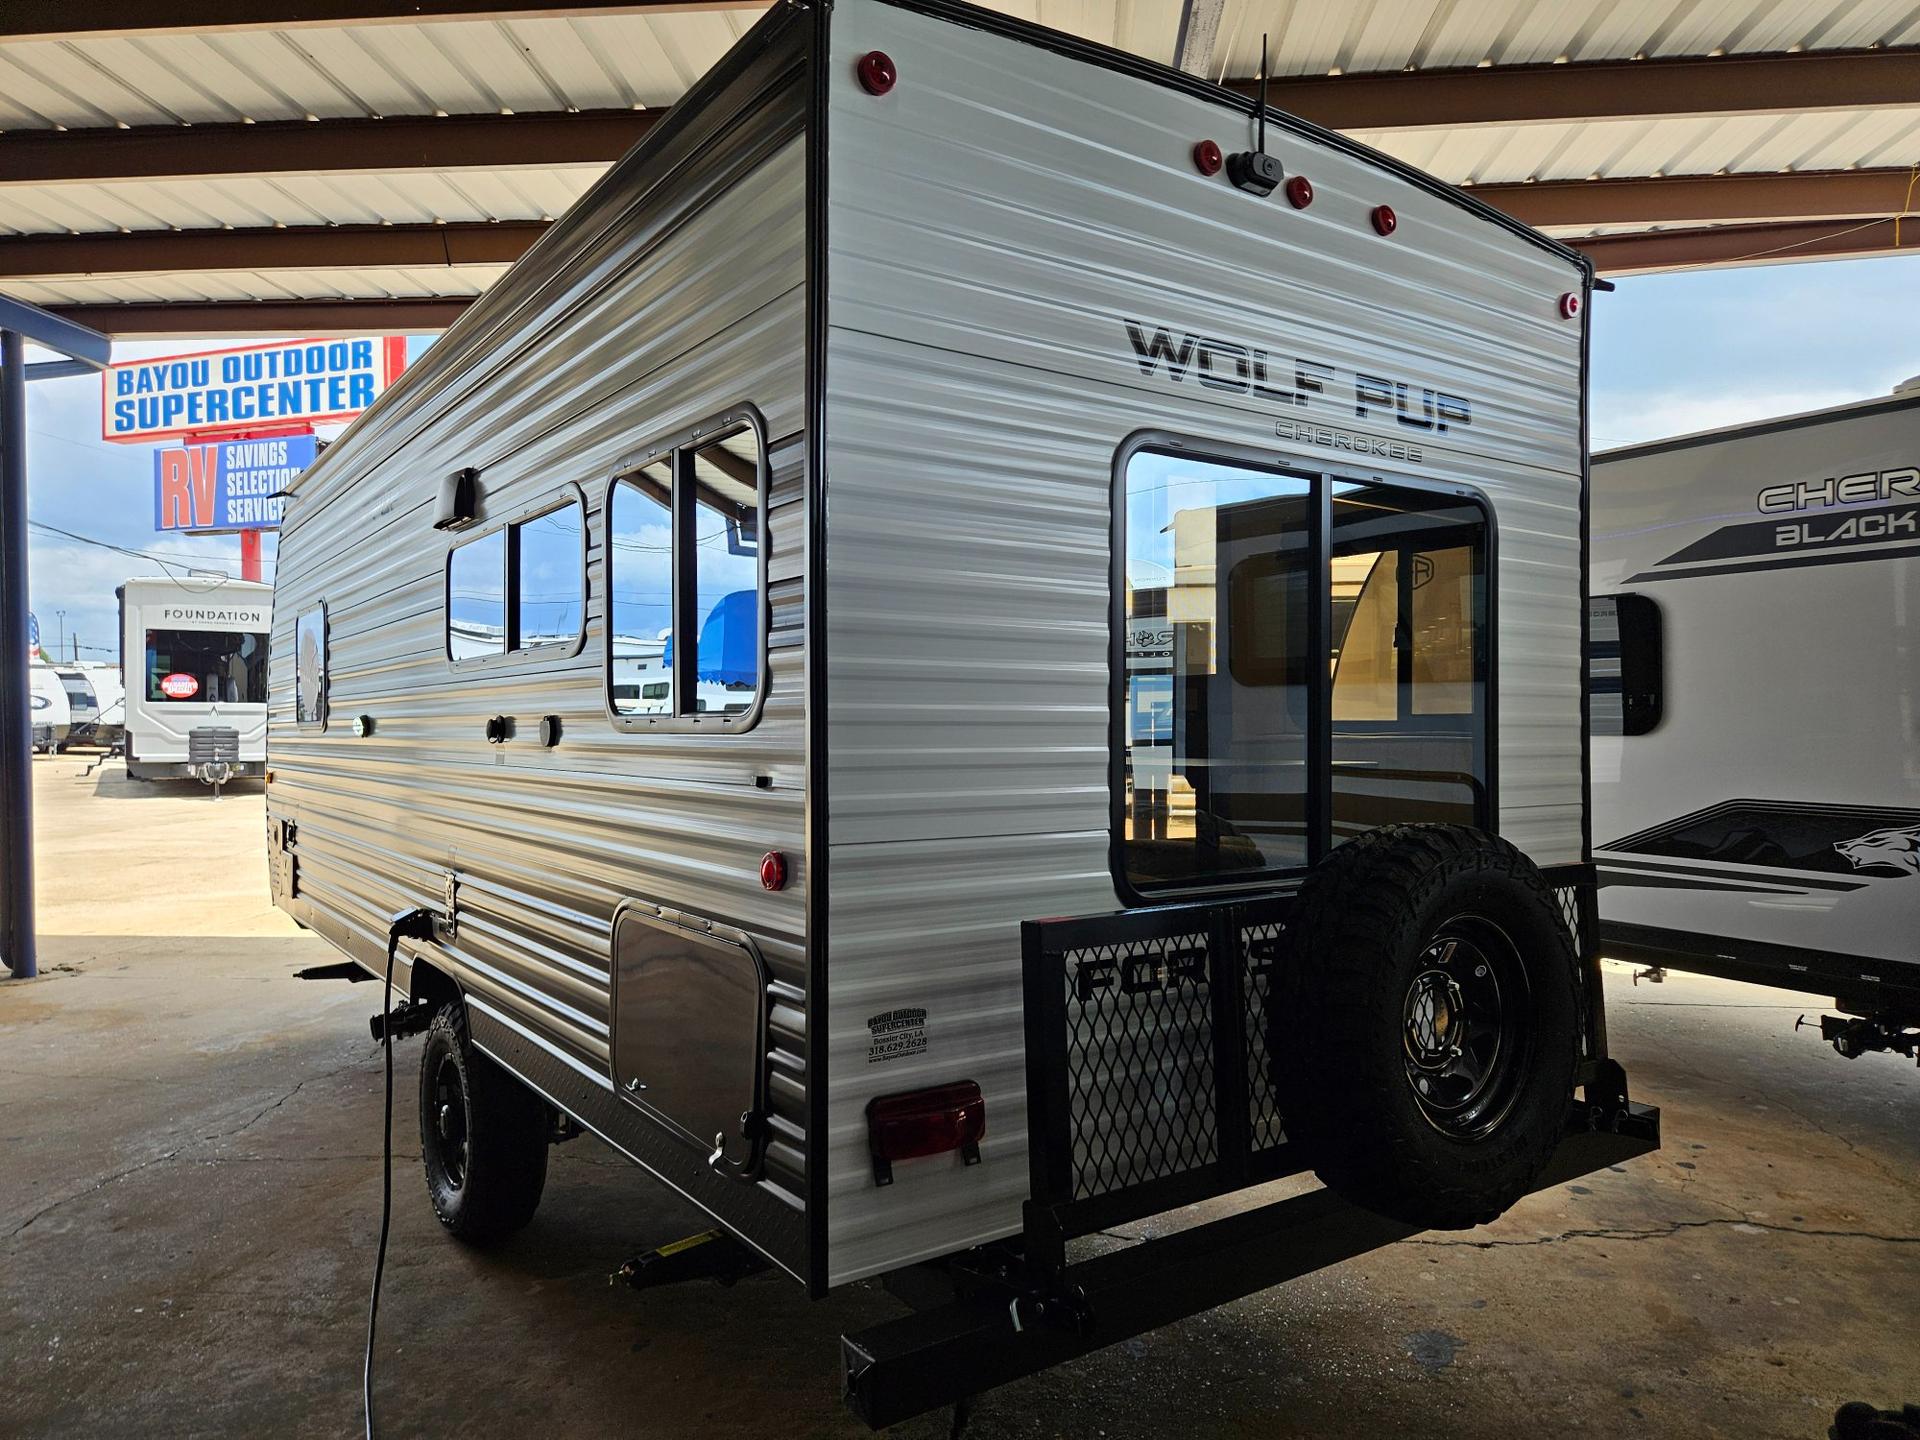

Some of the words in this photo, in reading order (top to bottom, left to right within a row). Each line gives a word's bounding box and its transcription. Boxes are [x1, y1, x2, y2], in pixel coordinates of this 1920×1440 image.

[117, 359, 209, 396] BAYOU
[222, 340, 373, 384] OUTDOOR
[1124, 319, 1335, 406] WOLF
[1356, 373, 1472, 436] PUP
[114, 372, 375, 432] SUPERCENTER
[226, 441, 288, 469] SAVINGS
[1275, 421, 1422, 462] CHEROKEE
[160, 446, 218, 529] RV
[1757, 466, 1920, 514] CHER
[227, 496, 286, 523] SERVICE
[1775, 510, 1917, 546] BLACK
[164, 609, 260, 622] FOUNDATION
[871, 1017, 925, 1036] SUPERCENTER
[873, 1034, 899, 1046] Bossier
[868, 1037, 928, 1056] 318.629.2628
